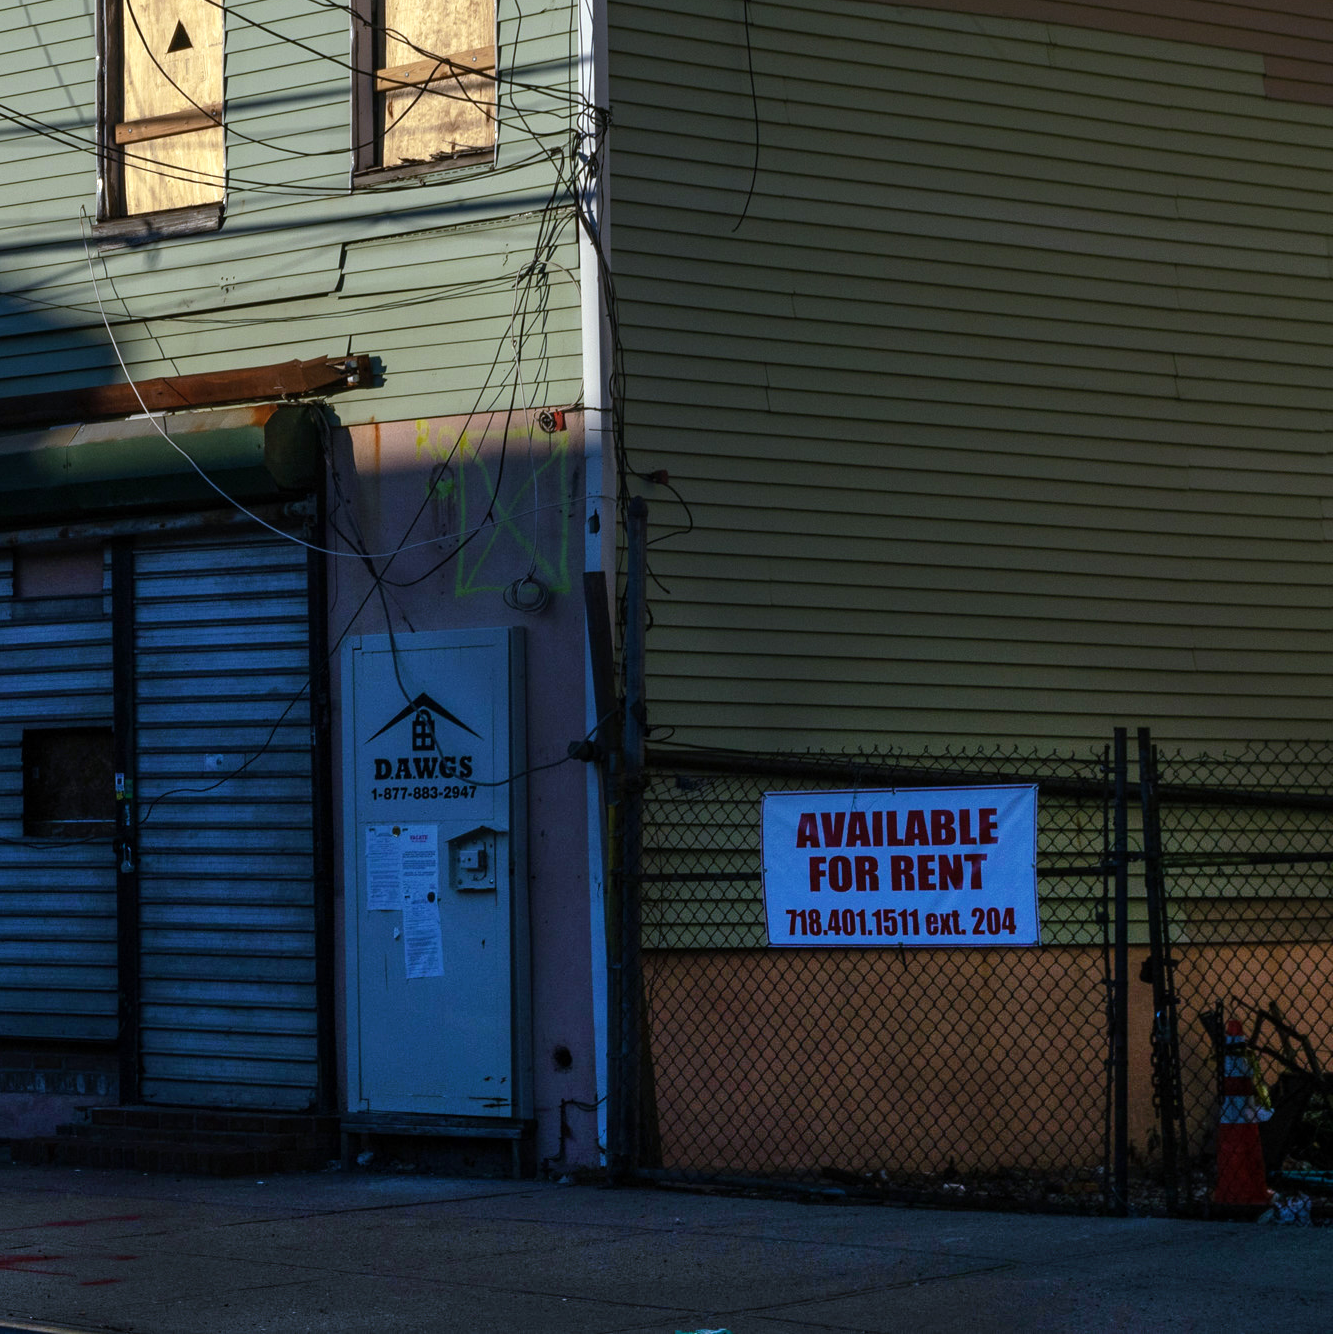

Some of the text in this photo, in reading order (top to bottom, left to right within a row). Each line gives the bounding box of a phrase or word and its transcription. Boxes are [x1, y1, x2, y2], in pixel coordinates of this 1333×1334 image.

[372, 786, 477, 800] 1-877-883-2947
[796, 808, 998, 848] AVAILABLE
[809, 854, 987, 892] FOR RENT
[786, 907, 1017, 936] 718.401.1511 ext. 204
